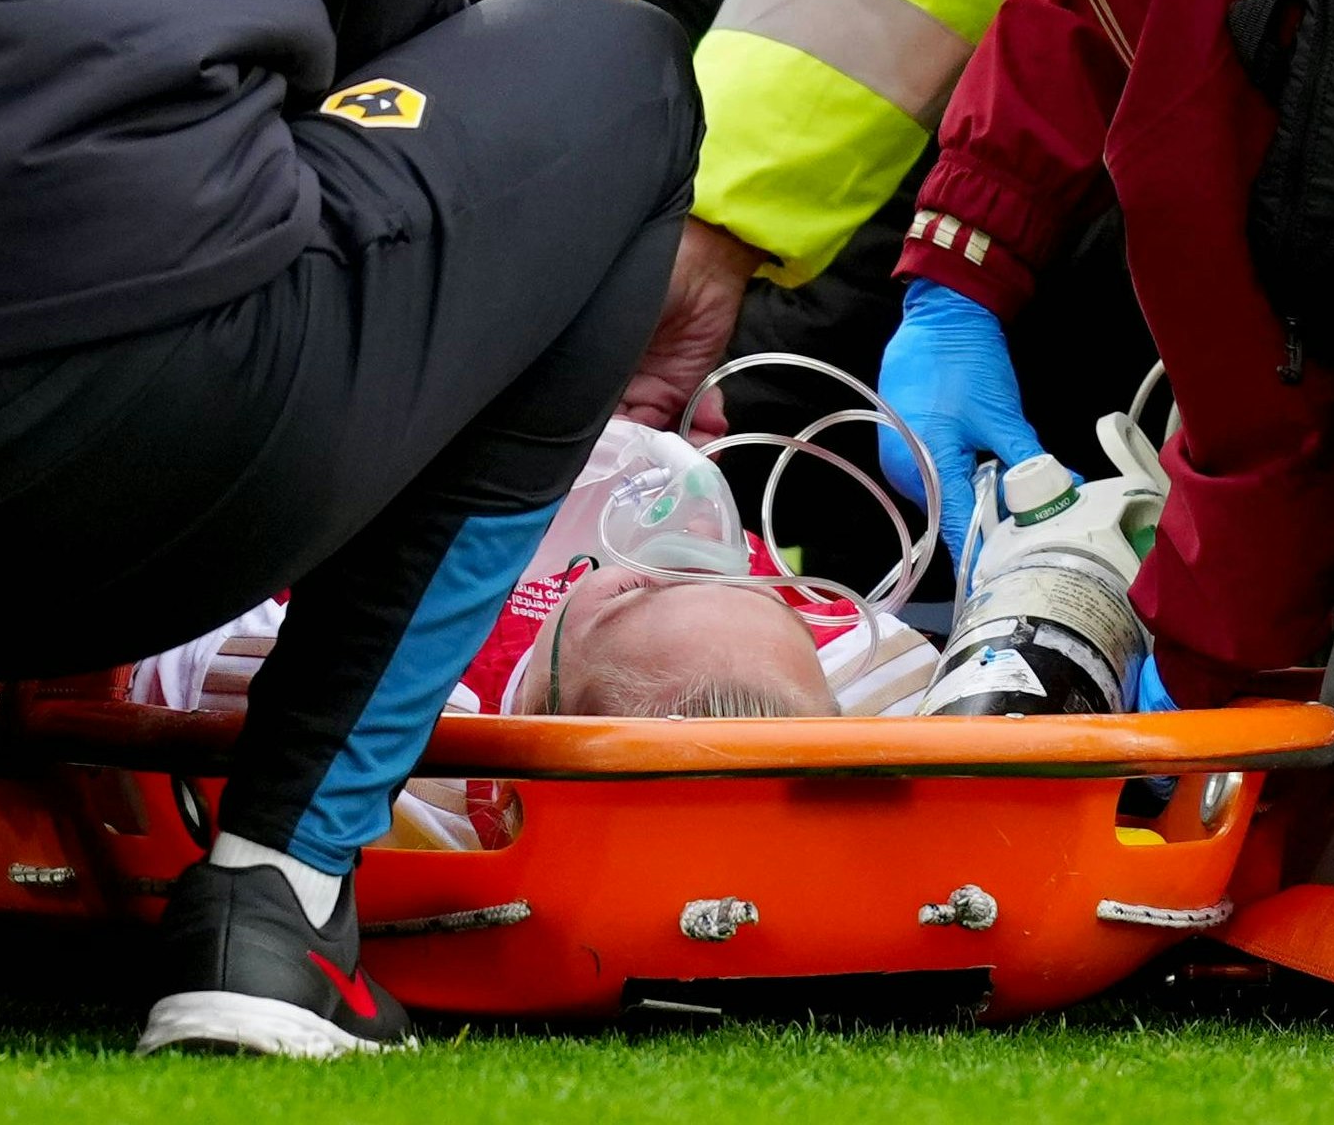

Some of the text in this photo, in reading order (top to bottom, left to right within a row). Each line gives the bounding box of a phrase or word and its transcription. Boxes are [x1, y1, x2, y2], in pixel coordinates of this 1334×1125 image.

[1034, 497, 1071, 521] OXYGEN
[512, 593, 555, 610] nental
[545, 589, 565, 600] up
[511, 605, 547, 621] elsea
